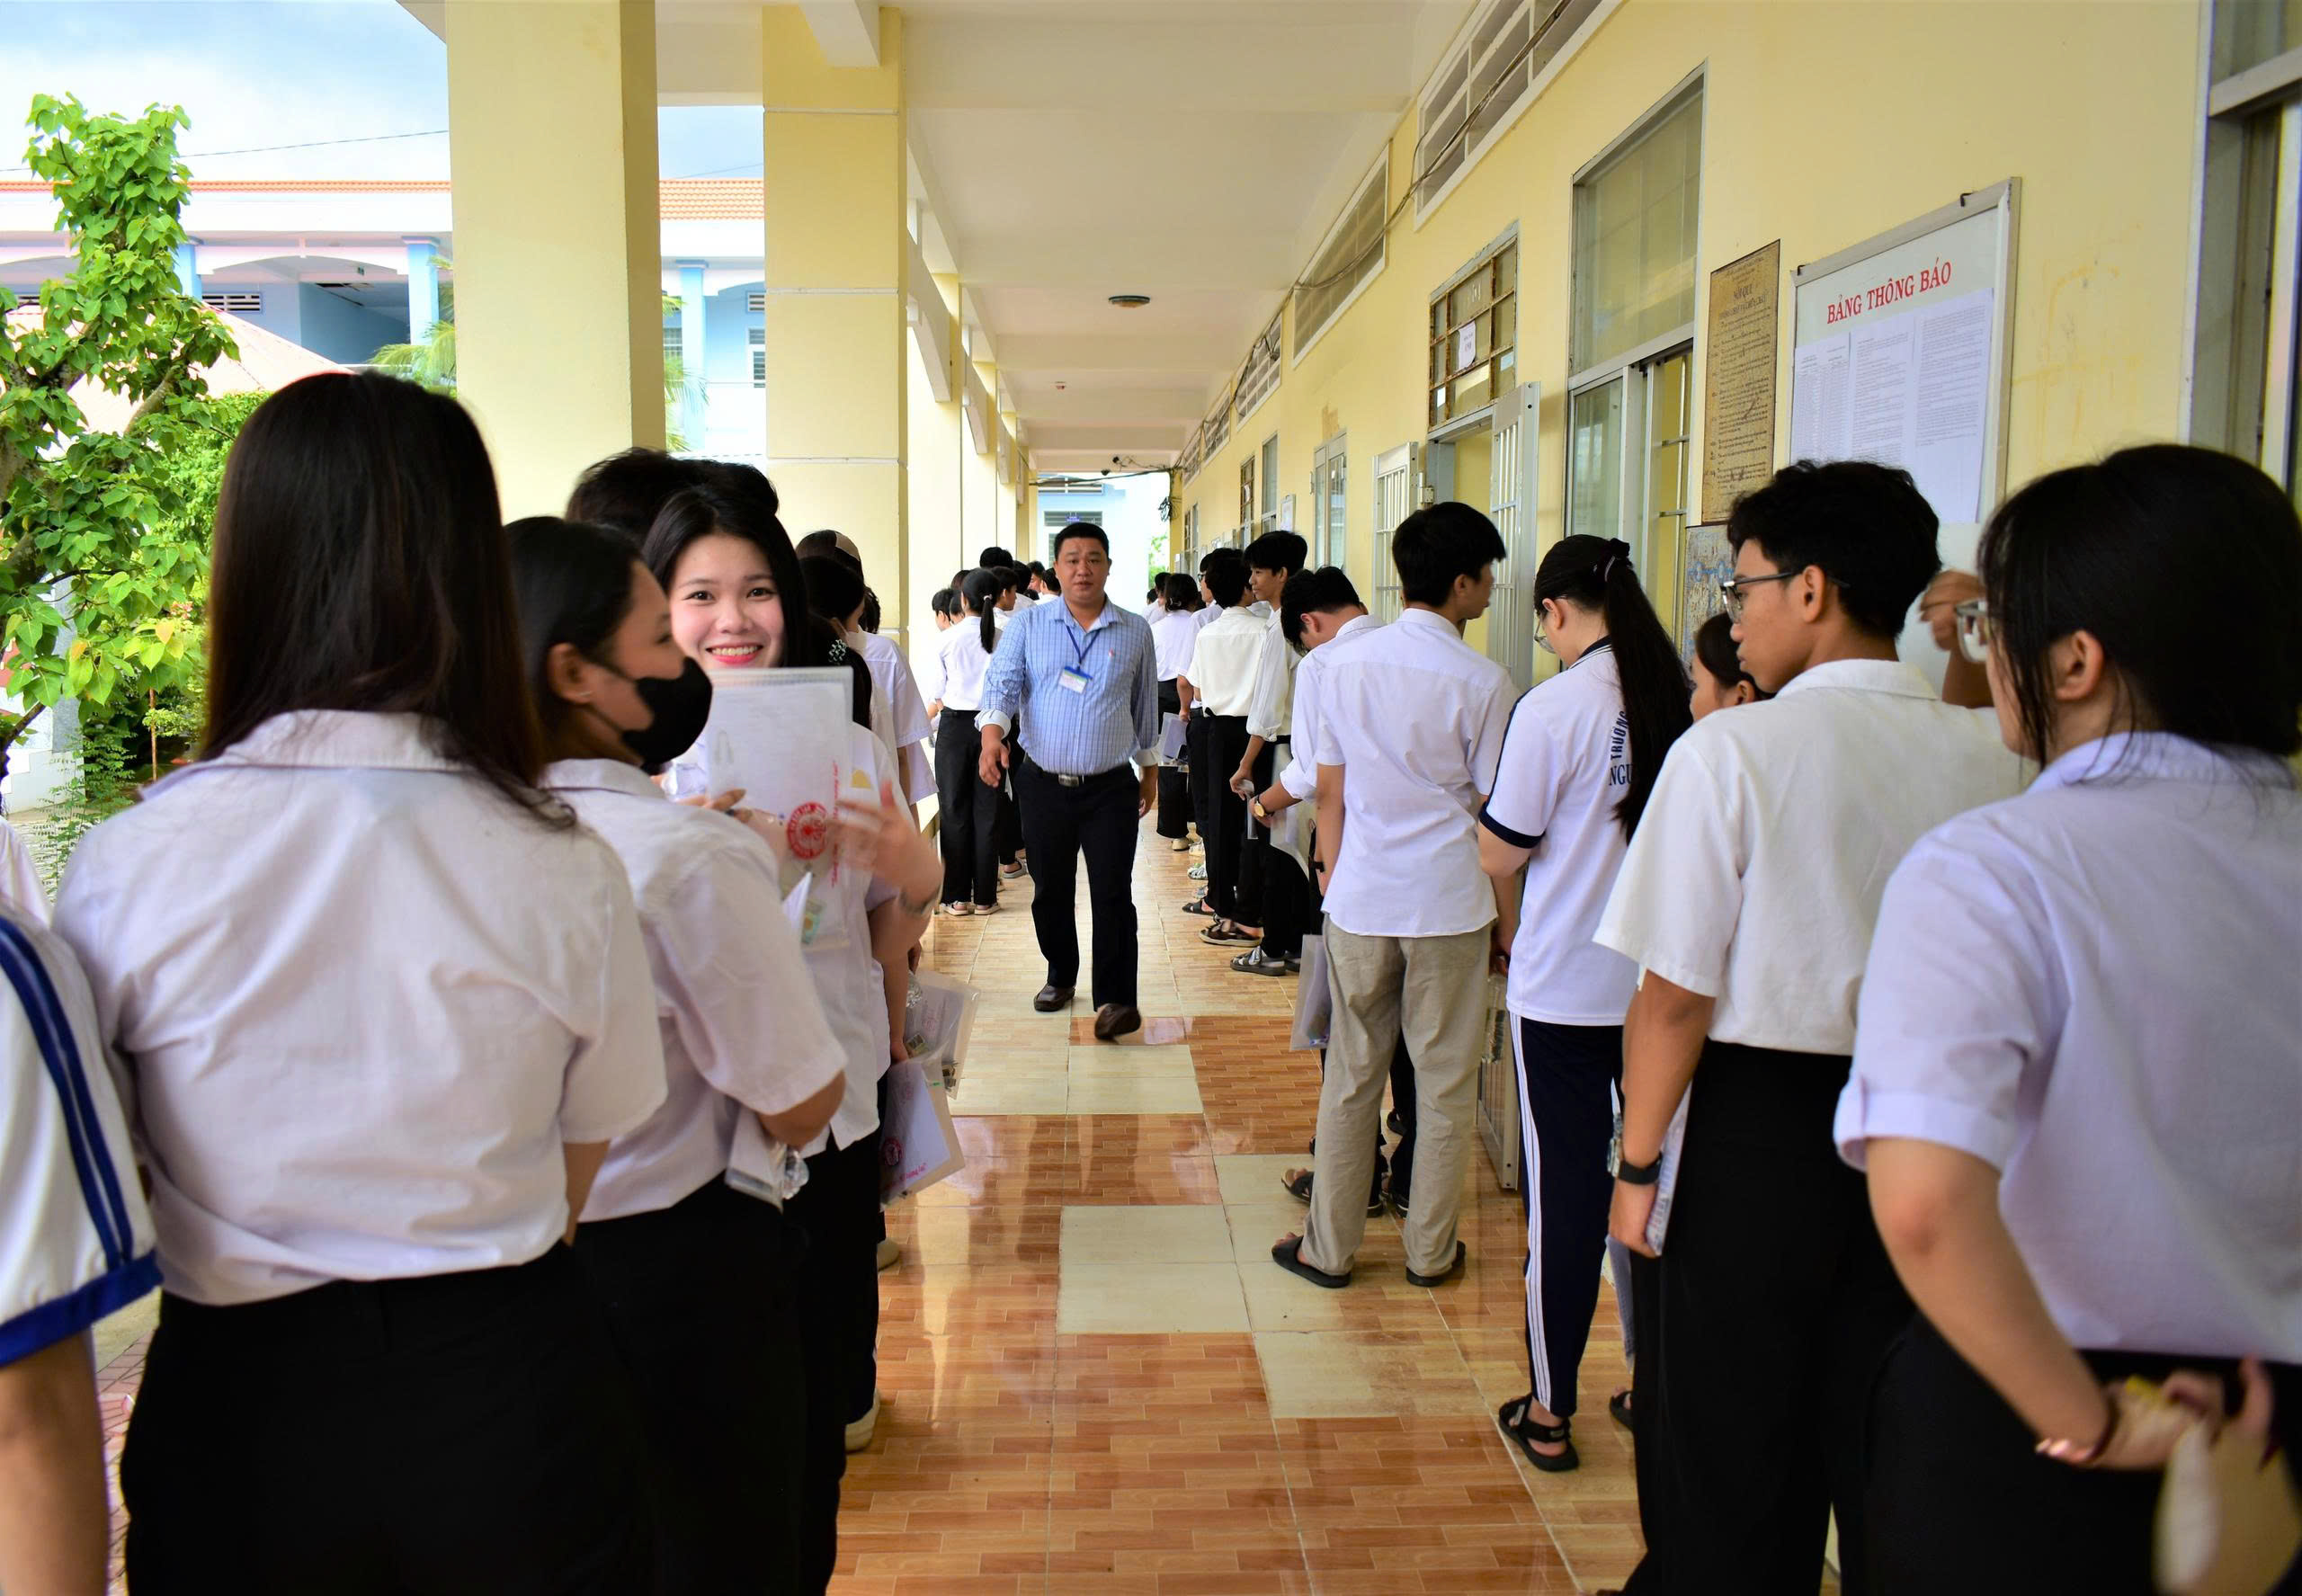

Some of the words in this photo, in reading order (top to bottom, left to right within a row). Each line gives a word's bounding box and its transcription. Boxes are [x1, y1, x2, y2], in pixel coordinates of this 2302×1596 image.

[1827, 294, 1862, 324] BẢNG
[1867, 275, 1915, 310] THÔNG
[1920, 256, 1951, 292] BÁO
